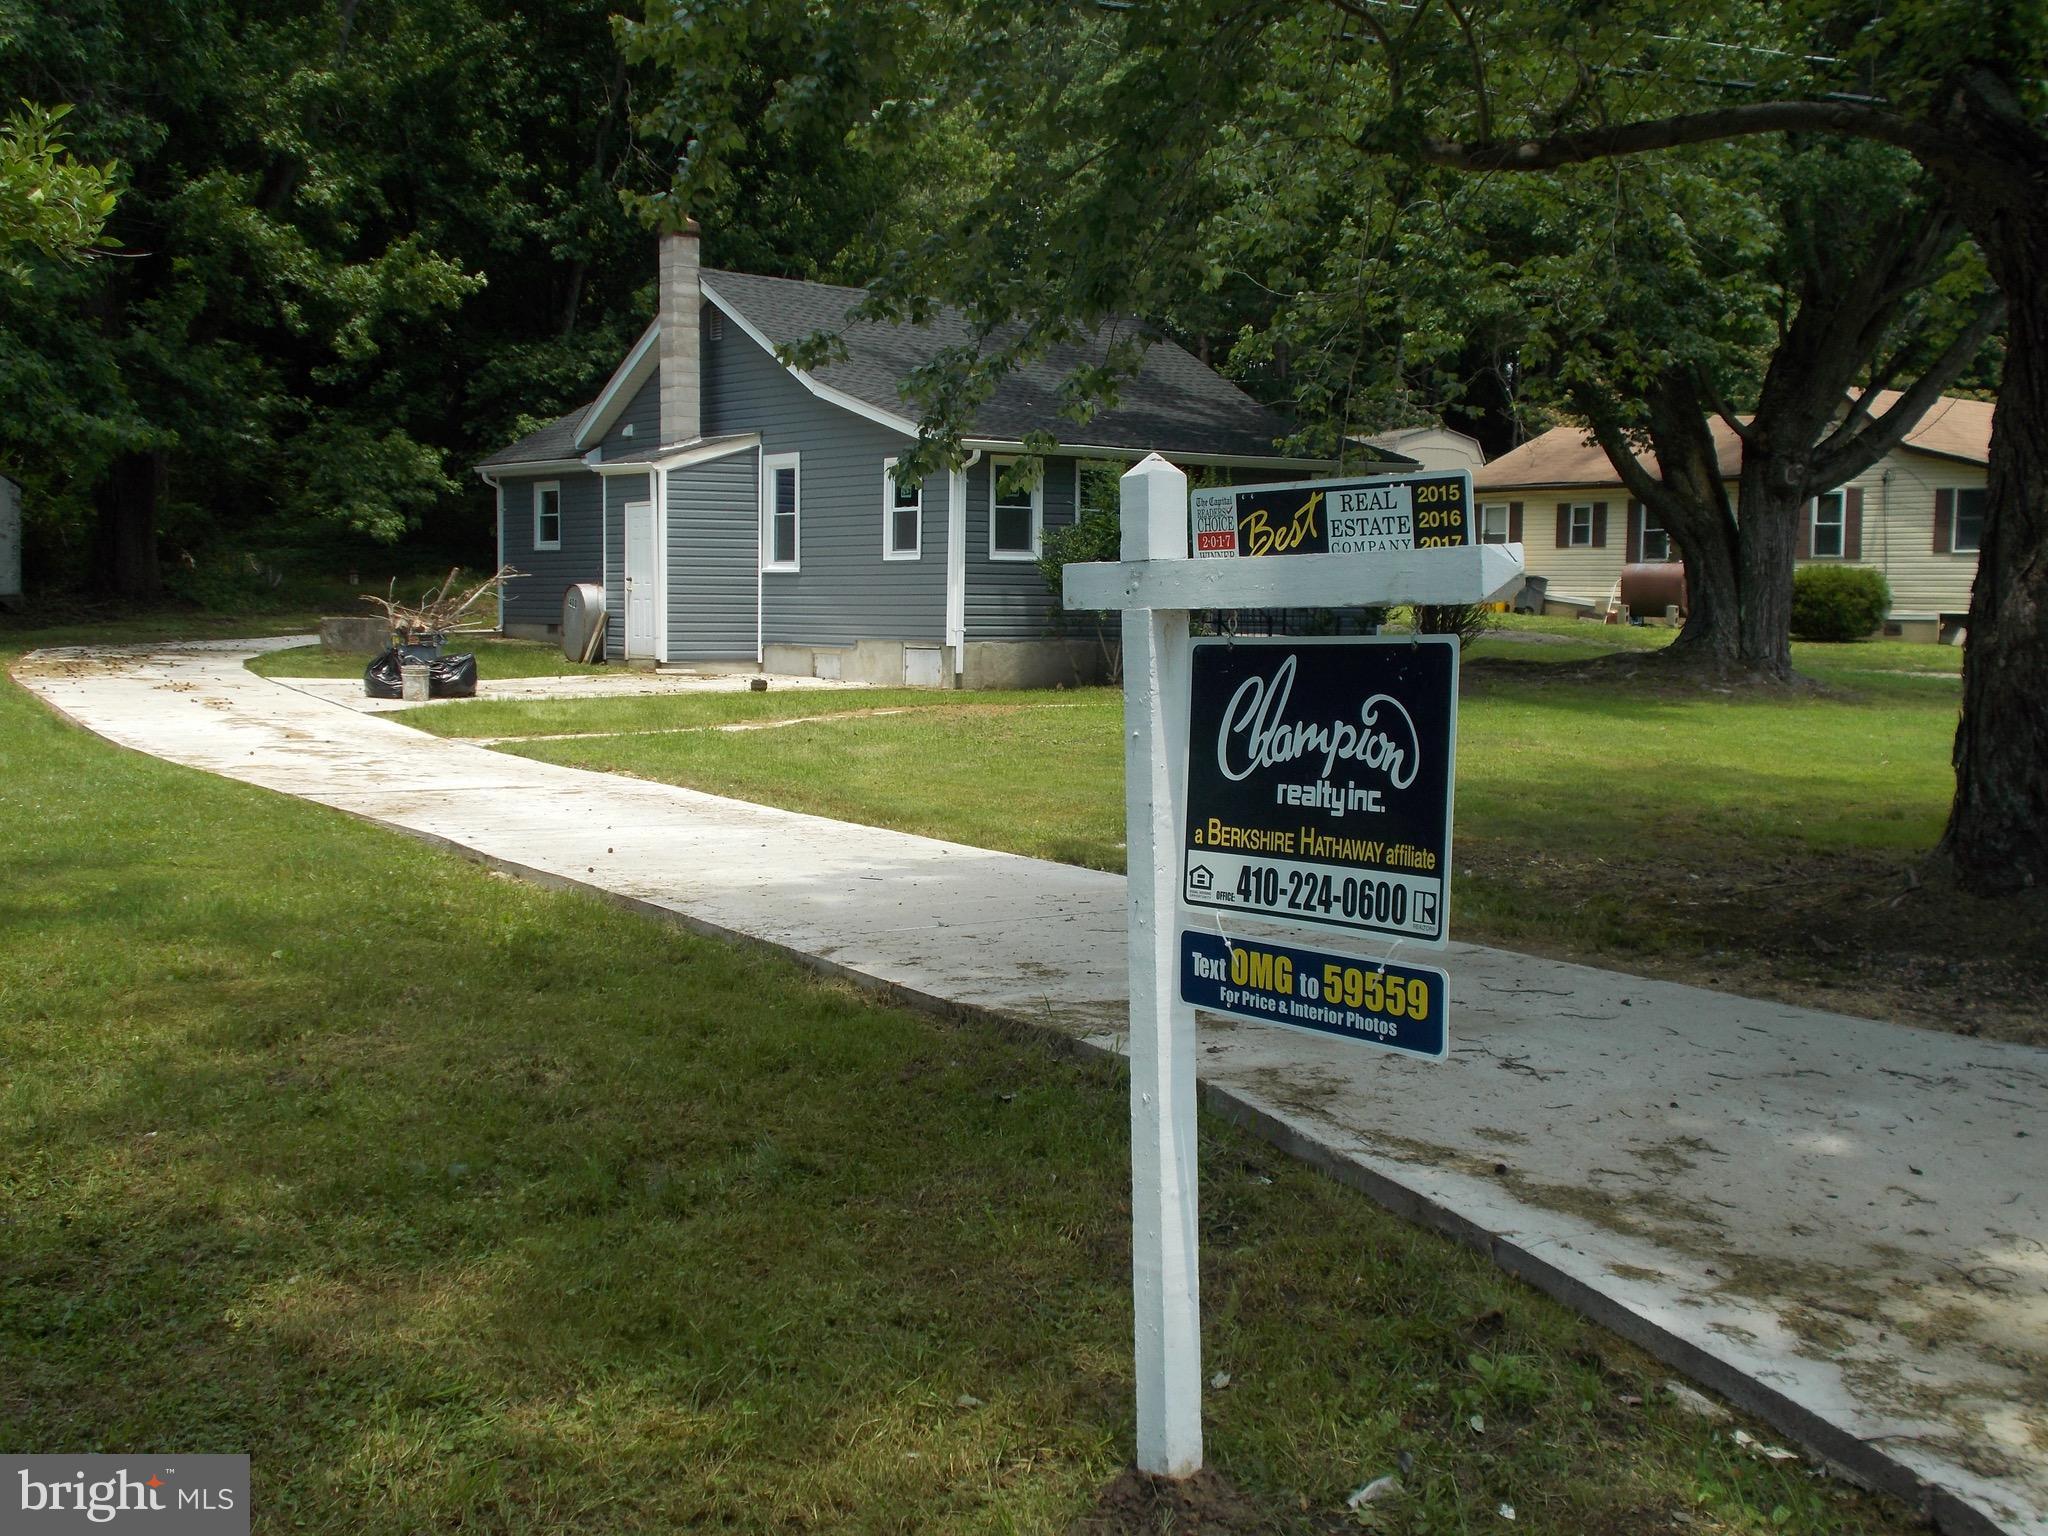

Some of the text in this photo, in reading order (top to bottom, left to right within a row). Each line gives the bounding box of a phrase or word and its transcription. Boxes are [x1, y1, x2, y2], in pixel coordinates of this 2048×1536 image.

[1340, 491, 1398, 512] REAL
[1417, 484, 1460, 503] 2015
[1197, 516, 1234, 532] CHOICE
[1239, 491, 1324, 556] Best
[1330, 515, 1411, 538] ESTATE
[1418, 510, 1462, 528] 2016
[1331, 539, 1412, 554] COMPANY
[1420, 535, 1462, 549] 2017
[1217, 654, 1420, 790] Champion
[1276, 779, 1386, 817] realty inc.
[1194, 817, 1436, 870] a BERKSHIRE HATHAWAY affiliate
[1236, 865, 1408, 926] 410-224-0600
[1192, 948, 1429, 1020] Text OMG to 59559
[1220, 986, 1398, 1037] For Price & Interior Photos
